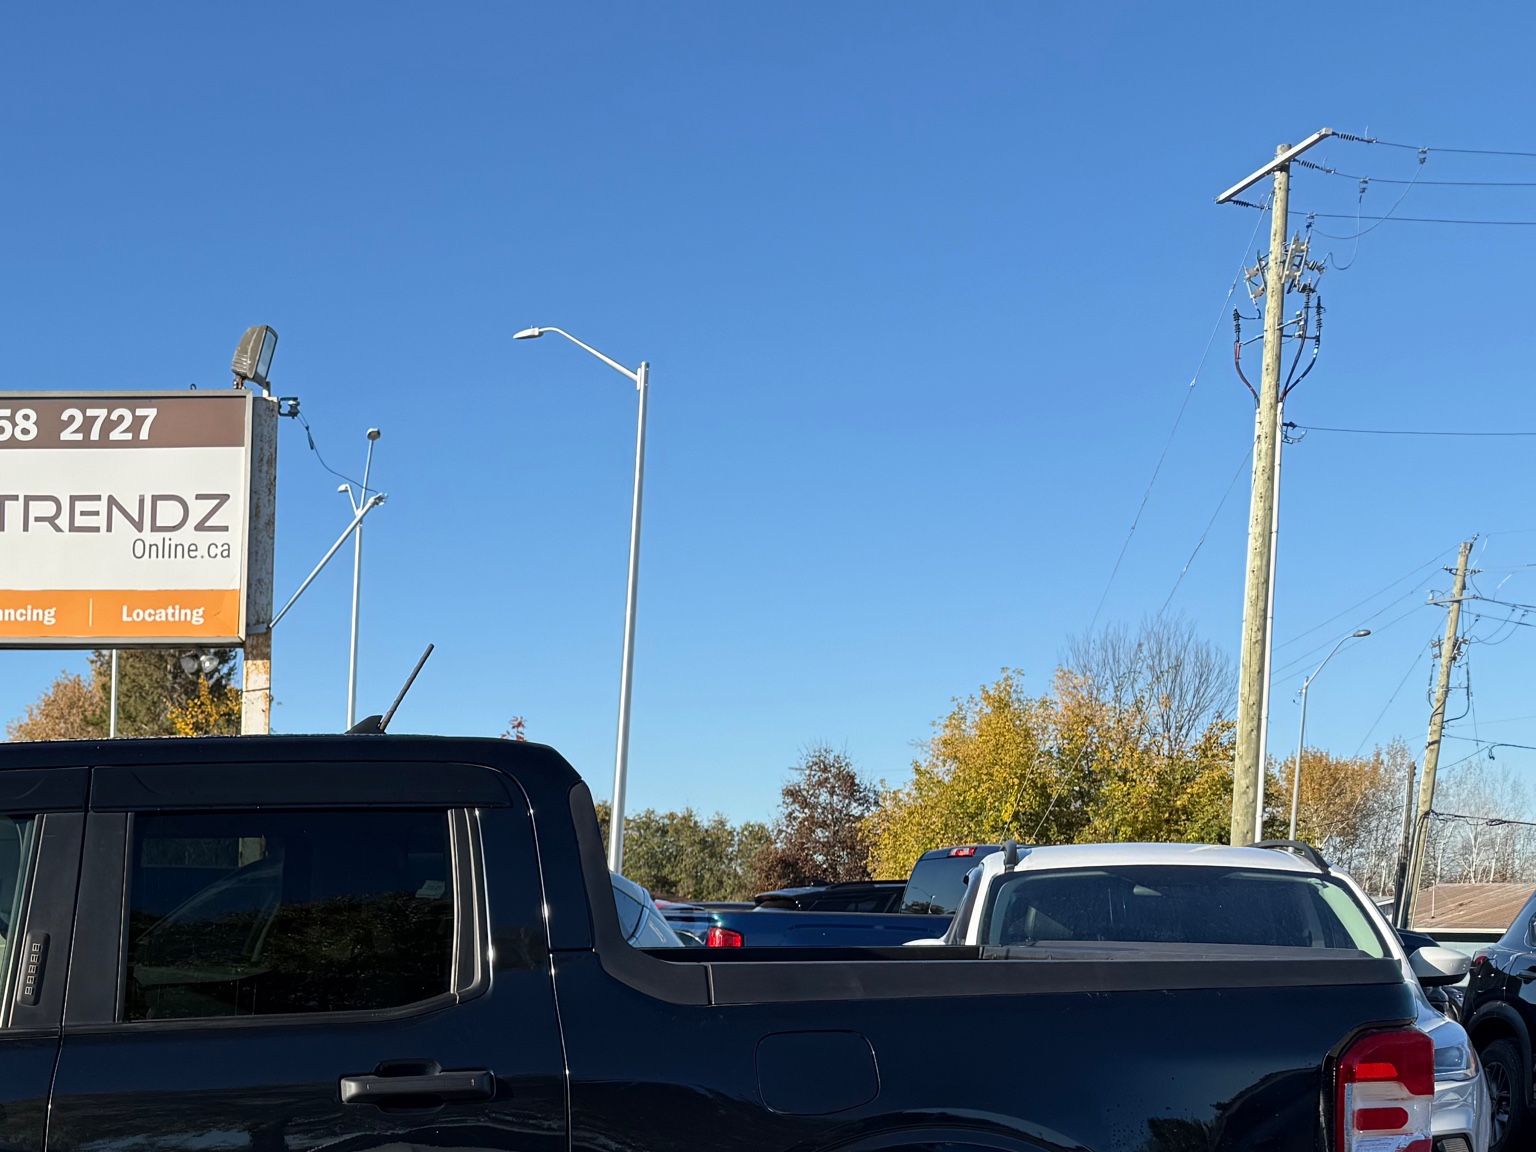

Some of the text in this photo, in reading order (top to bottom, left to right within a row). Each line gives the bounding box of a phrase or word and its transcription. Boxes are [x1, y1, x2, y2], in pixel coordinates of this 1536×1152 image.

[59, 407, 158, 441] 2727
[132, 538, 231, 561] Online.ca
[121, 605, 205, 626] Locating
